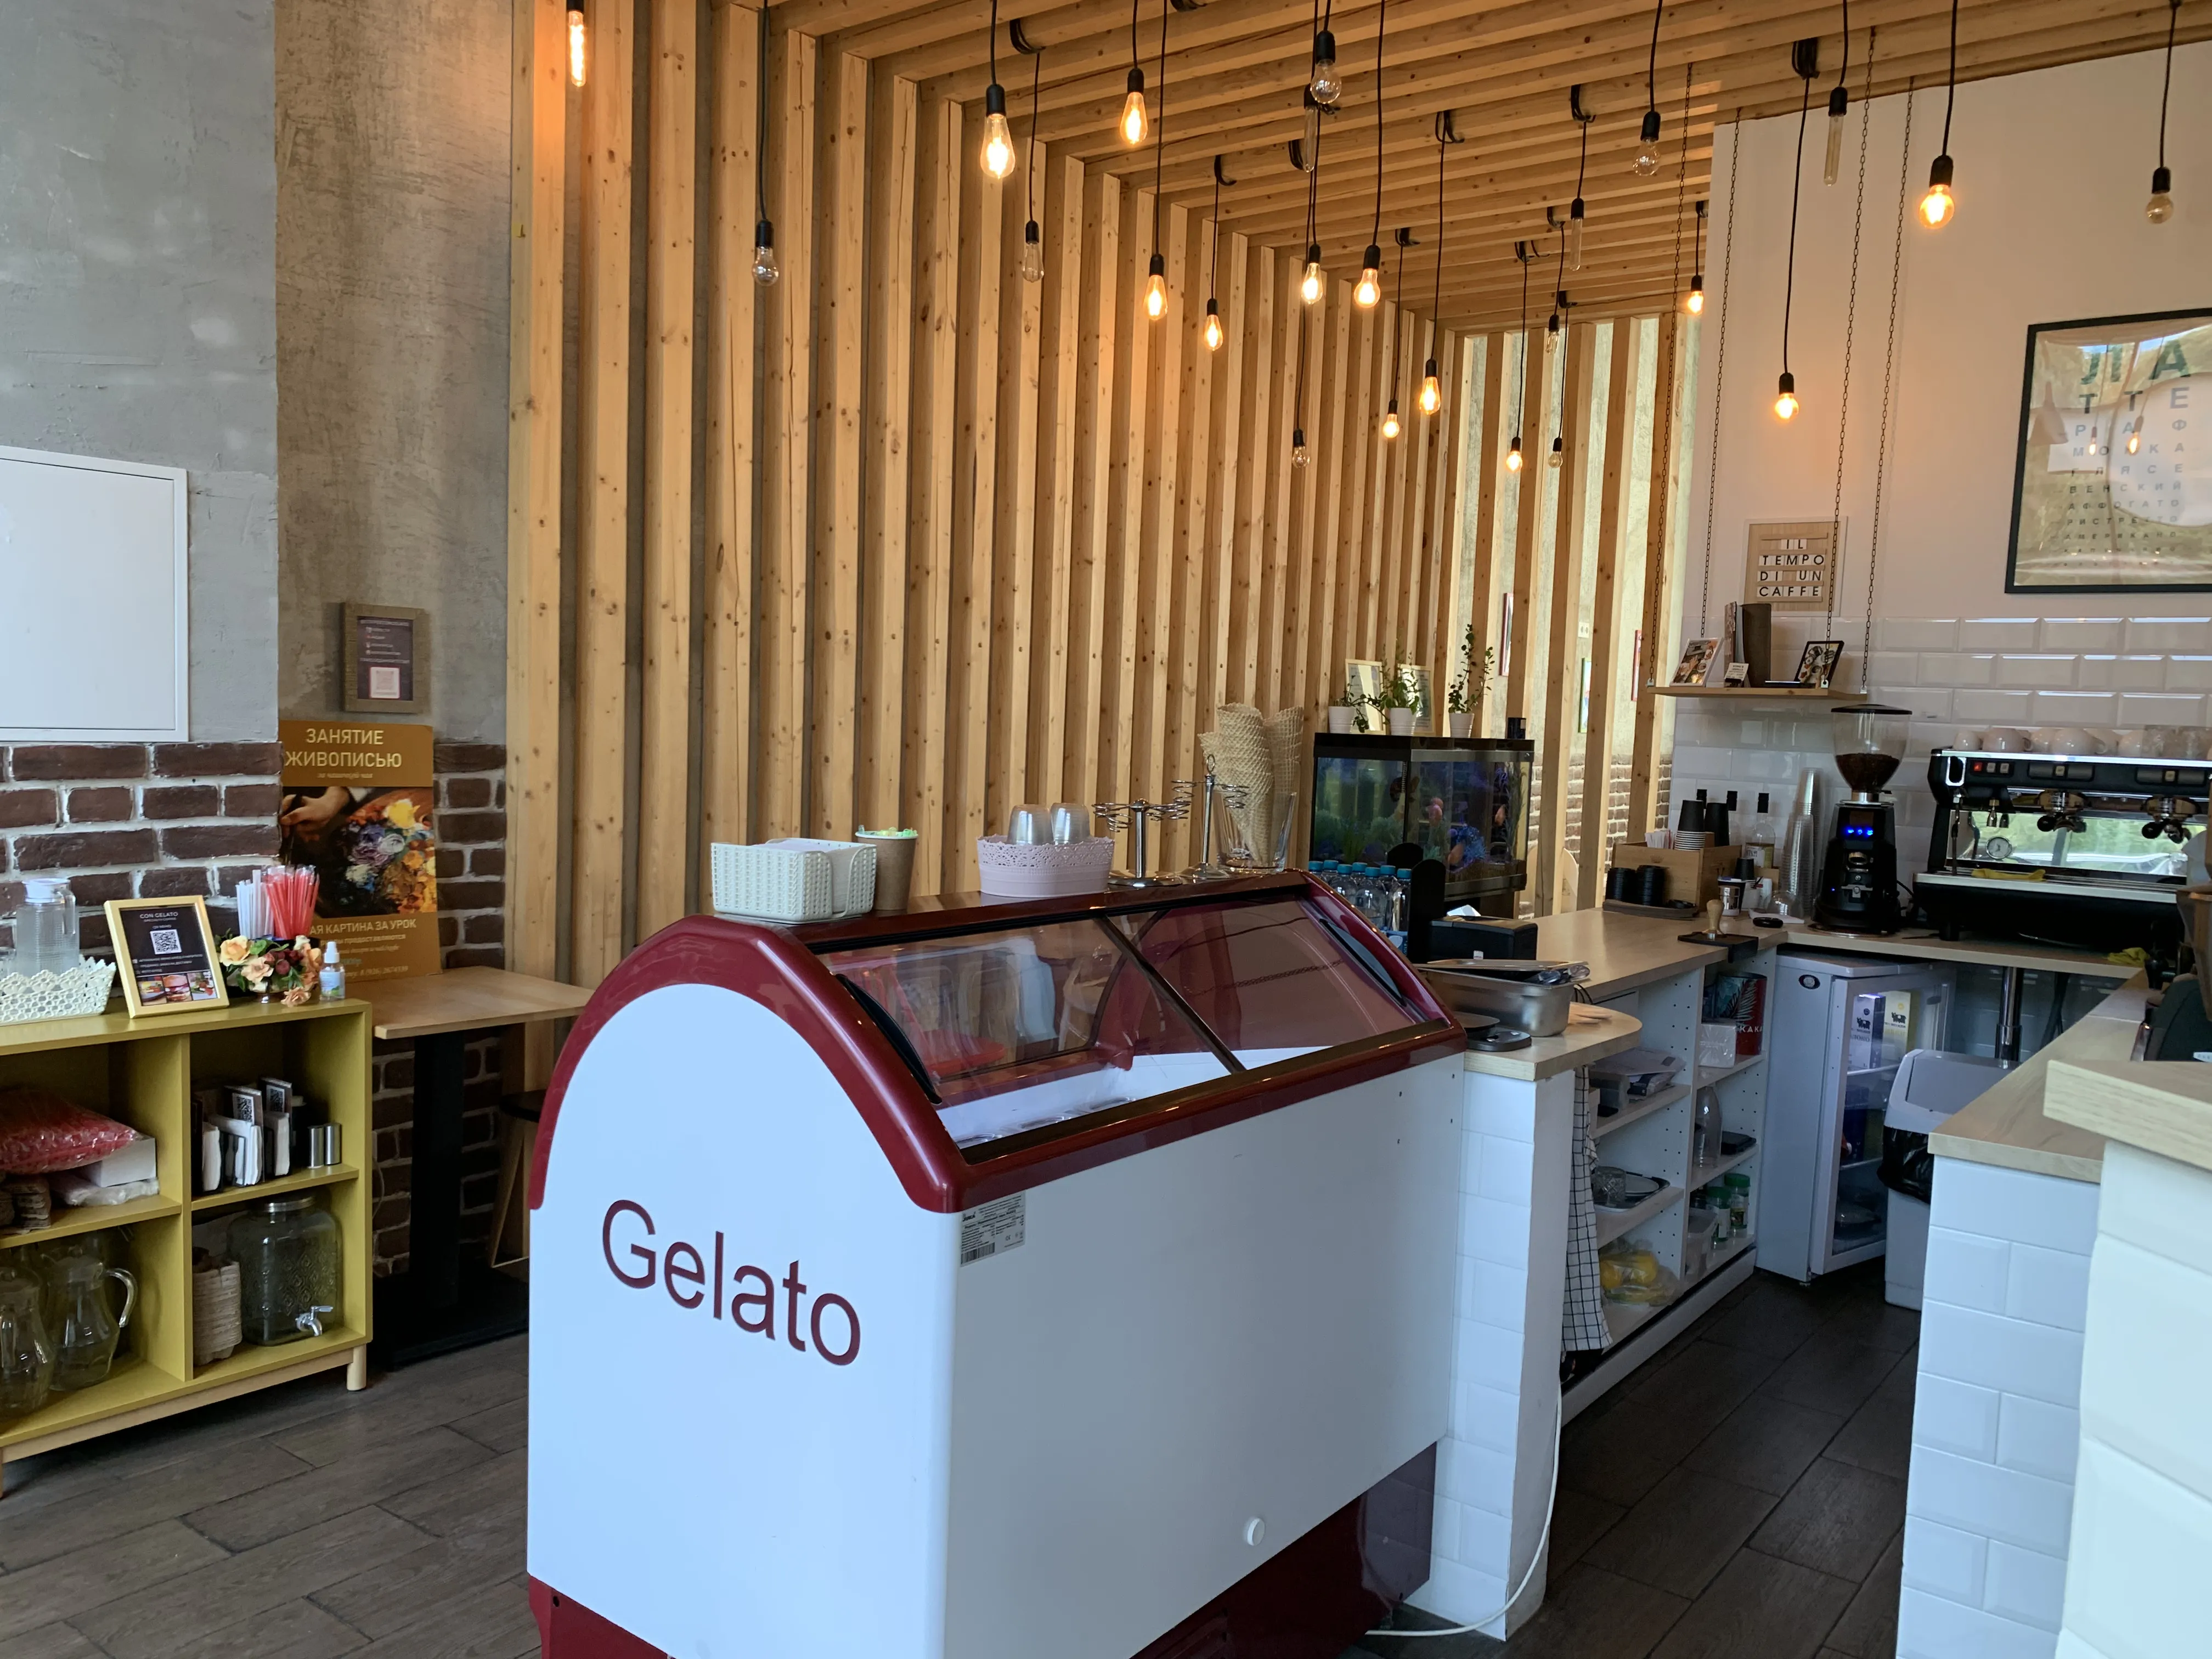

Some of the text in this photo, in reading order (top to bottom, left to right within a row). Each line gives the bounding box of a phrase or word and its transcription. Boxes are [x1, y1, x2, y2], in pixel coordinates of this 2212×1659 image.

[2079, 386, 2190, 414] ТТЕ
[2073, 443, 2185, 457] МОКА
[2069, 480, 2181, 494] ВЕНСКИЙ
[2068, 499, 2179, 510] АФФОГАТО
[1786, 539, 1803, 549] IL
[1763, 554, 1824, 566] TEMPO
[1760, 570, 1821, 582] DI UN
[1759, 586, 1819, 596] CAFFE
[306, 728, 384, 745] ЗАНЯТИЕ
[285, 751, 402, 768] ЖИВОПИСЬЮ
[309, 918, 417, 935] АЯ КАРТИНА ЗА УРОК
[601, 1199, 861, 1366] Gelato
